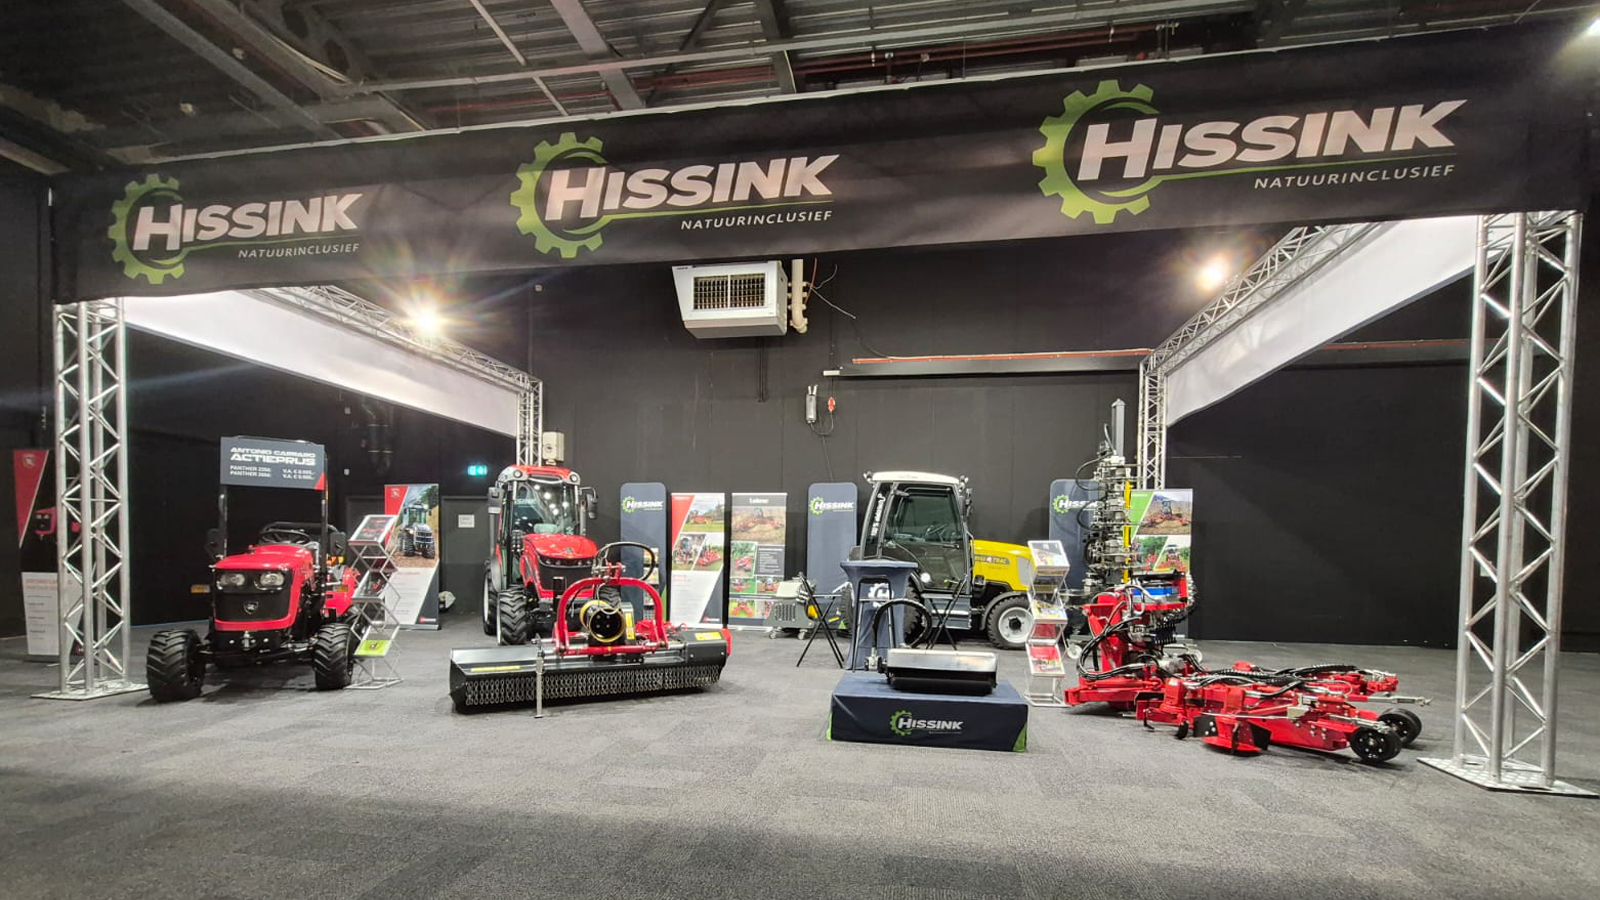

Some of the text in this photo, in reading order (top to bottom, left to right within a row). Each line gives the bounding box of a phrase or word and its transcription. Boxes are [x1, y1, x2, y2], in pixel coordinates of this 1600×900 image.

[1077, 99, 1467, 181] HISSINK
[1254, 164, 1456, 189] NATUURINCLUSIEF
[545, 154, 840, 221] HISSINK
[133, 193, 363, 251] HISSINK
[680, 210, 833, 230] NATUURINCLUSIEF
[238, 243, 359, 259] NATUURINCLUSIEF
[230, 447, 272, 455] ANTONIO
[626, 500, 664, 509] HISSINK
[814, 501, 854, 510] HISSINK
[898, 718, 963, 730] HISSINK
